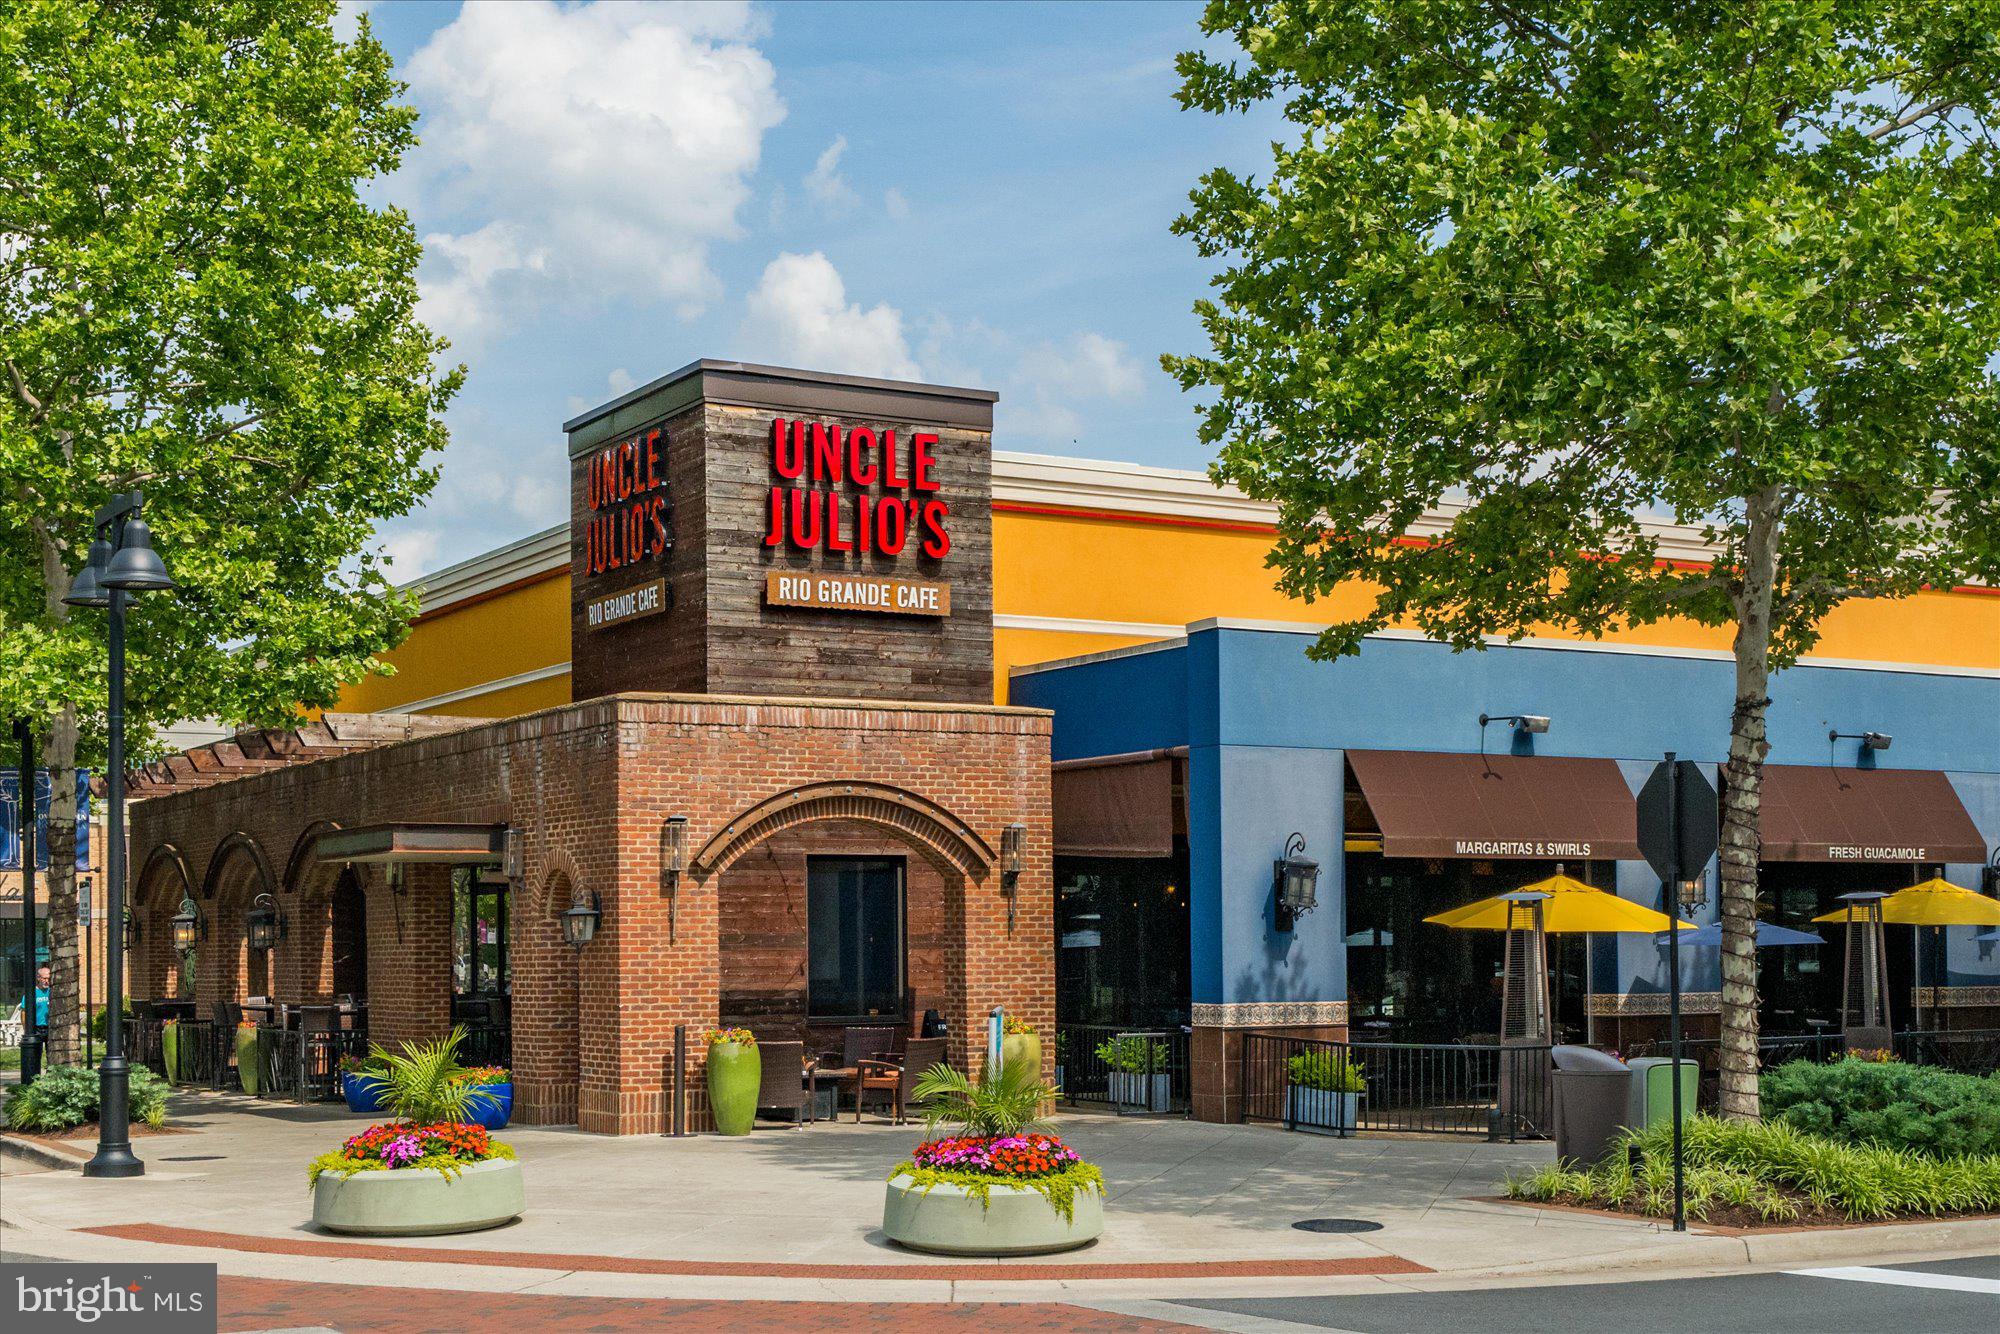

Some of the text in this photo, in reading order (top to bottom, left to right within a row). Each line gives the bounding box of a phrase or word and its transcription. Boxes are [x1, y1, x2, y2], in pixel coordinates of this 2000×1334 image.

[588, 428, 661, 511] UNCLE
[772, 418, 940, 491] UNCLE
[585, 495, 667, 577] JULIO'S
[764, 487, 951, 559] JULIO'S
[588, 585, 659, 626] RIO GRANDE CAFE
[779, 577, 939, 610] RIO GRANDE CAFE
[1456, 841, 1591, 856] MARGARITAS & SWIRLS
[1829, 846, 1925, 860] FRESH GUACAMOLE
